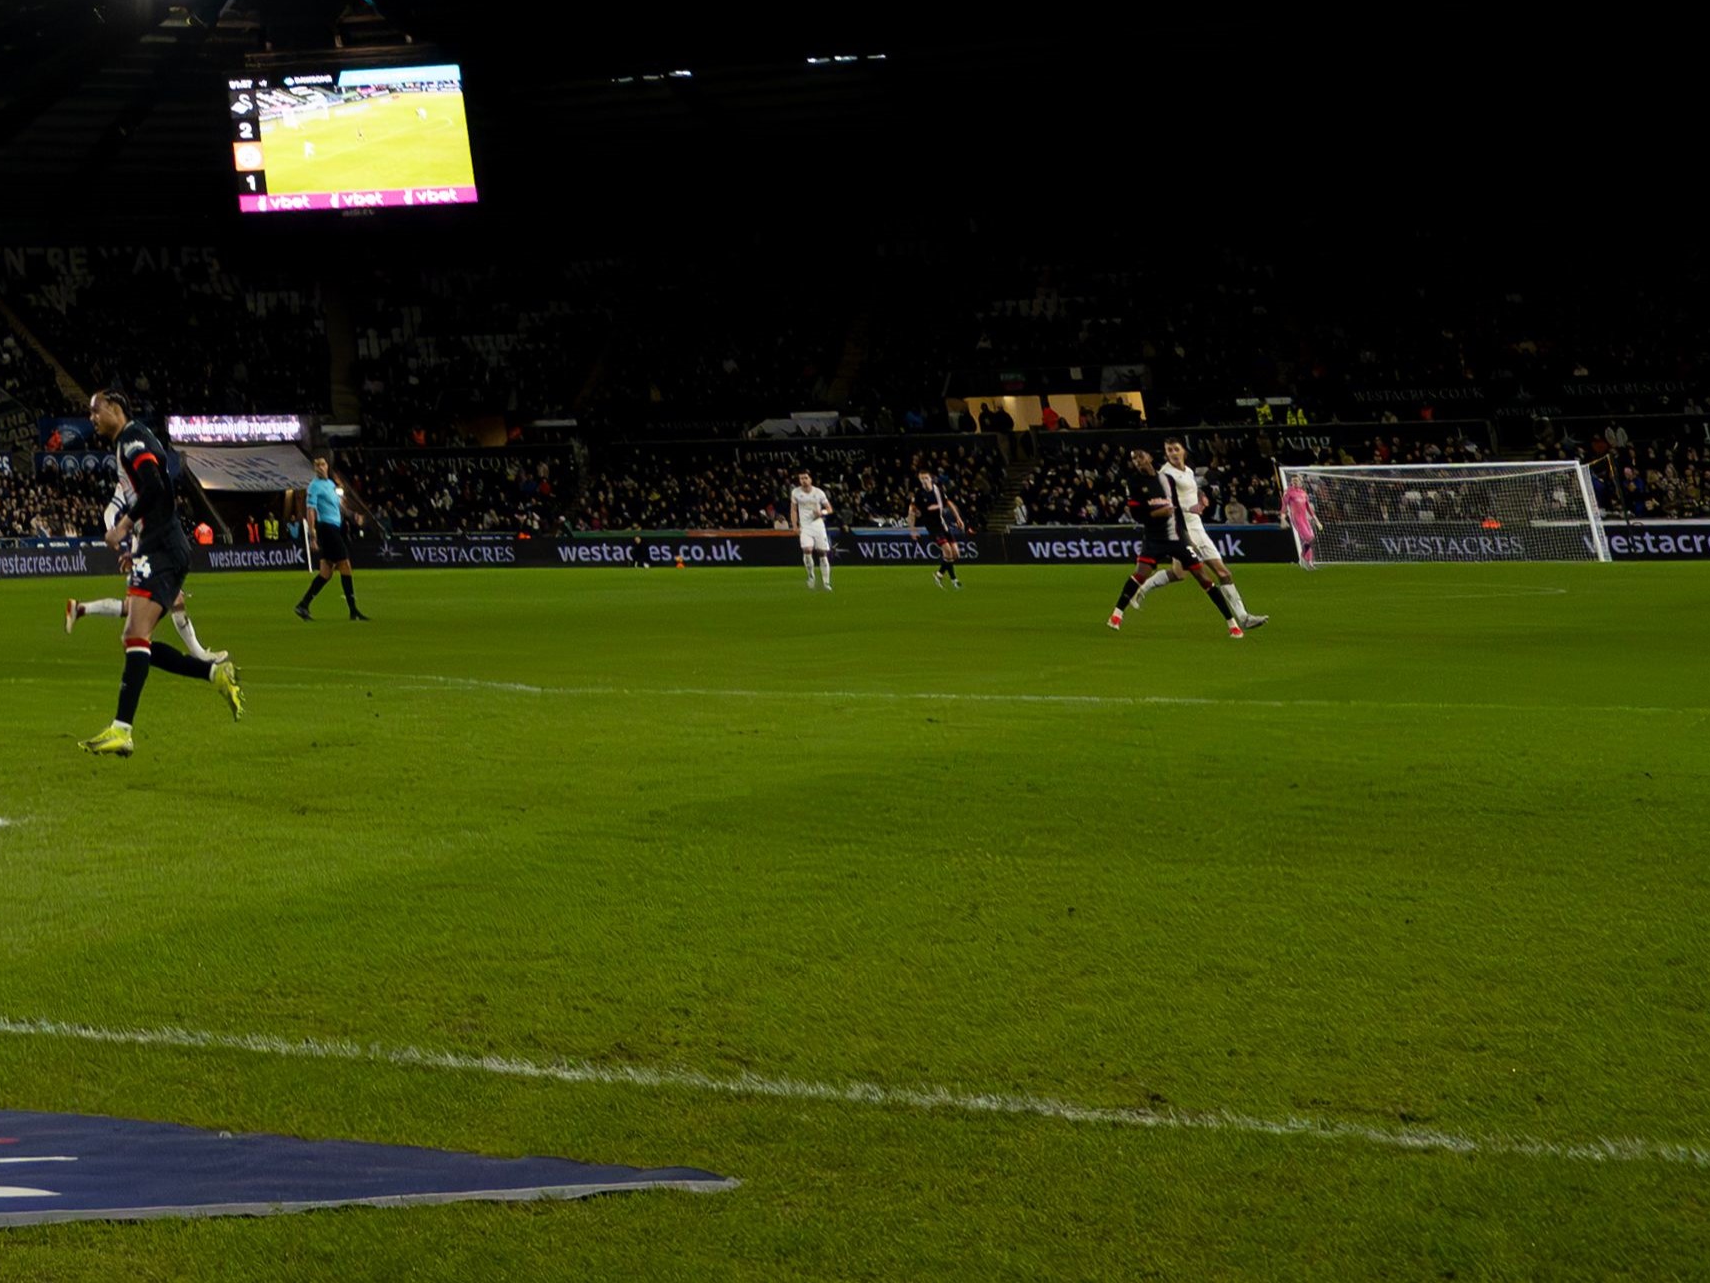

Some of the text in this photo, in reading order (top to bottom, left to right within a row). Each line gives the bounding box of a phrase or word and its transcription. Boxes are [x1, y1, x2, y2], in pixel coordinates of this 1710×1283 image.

[238, 122, 253, 139] 2
[245, 174, 257, 192] 1
[269, 193, 311, 209] vbet
[343, 191, 384, 206] vbet
[415, 187, 458, 203] vbet
[410, 544, 516, 563] WESTACRES
[558, 539, 743, 564] westaces.co.uk
[857, 540, 979, 560] WESTACES
[1380, 535, 1526, 557] WESTACRES
[208, 543, 305, 568] westacres.co.uk
